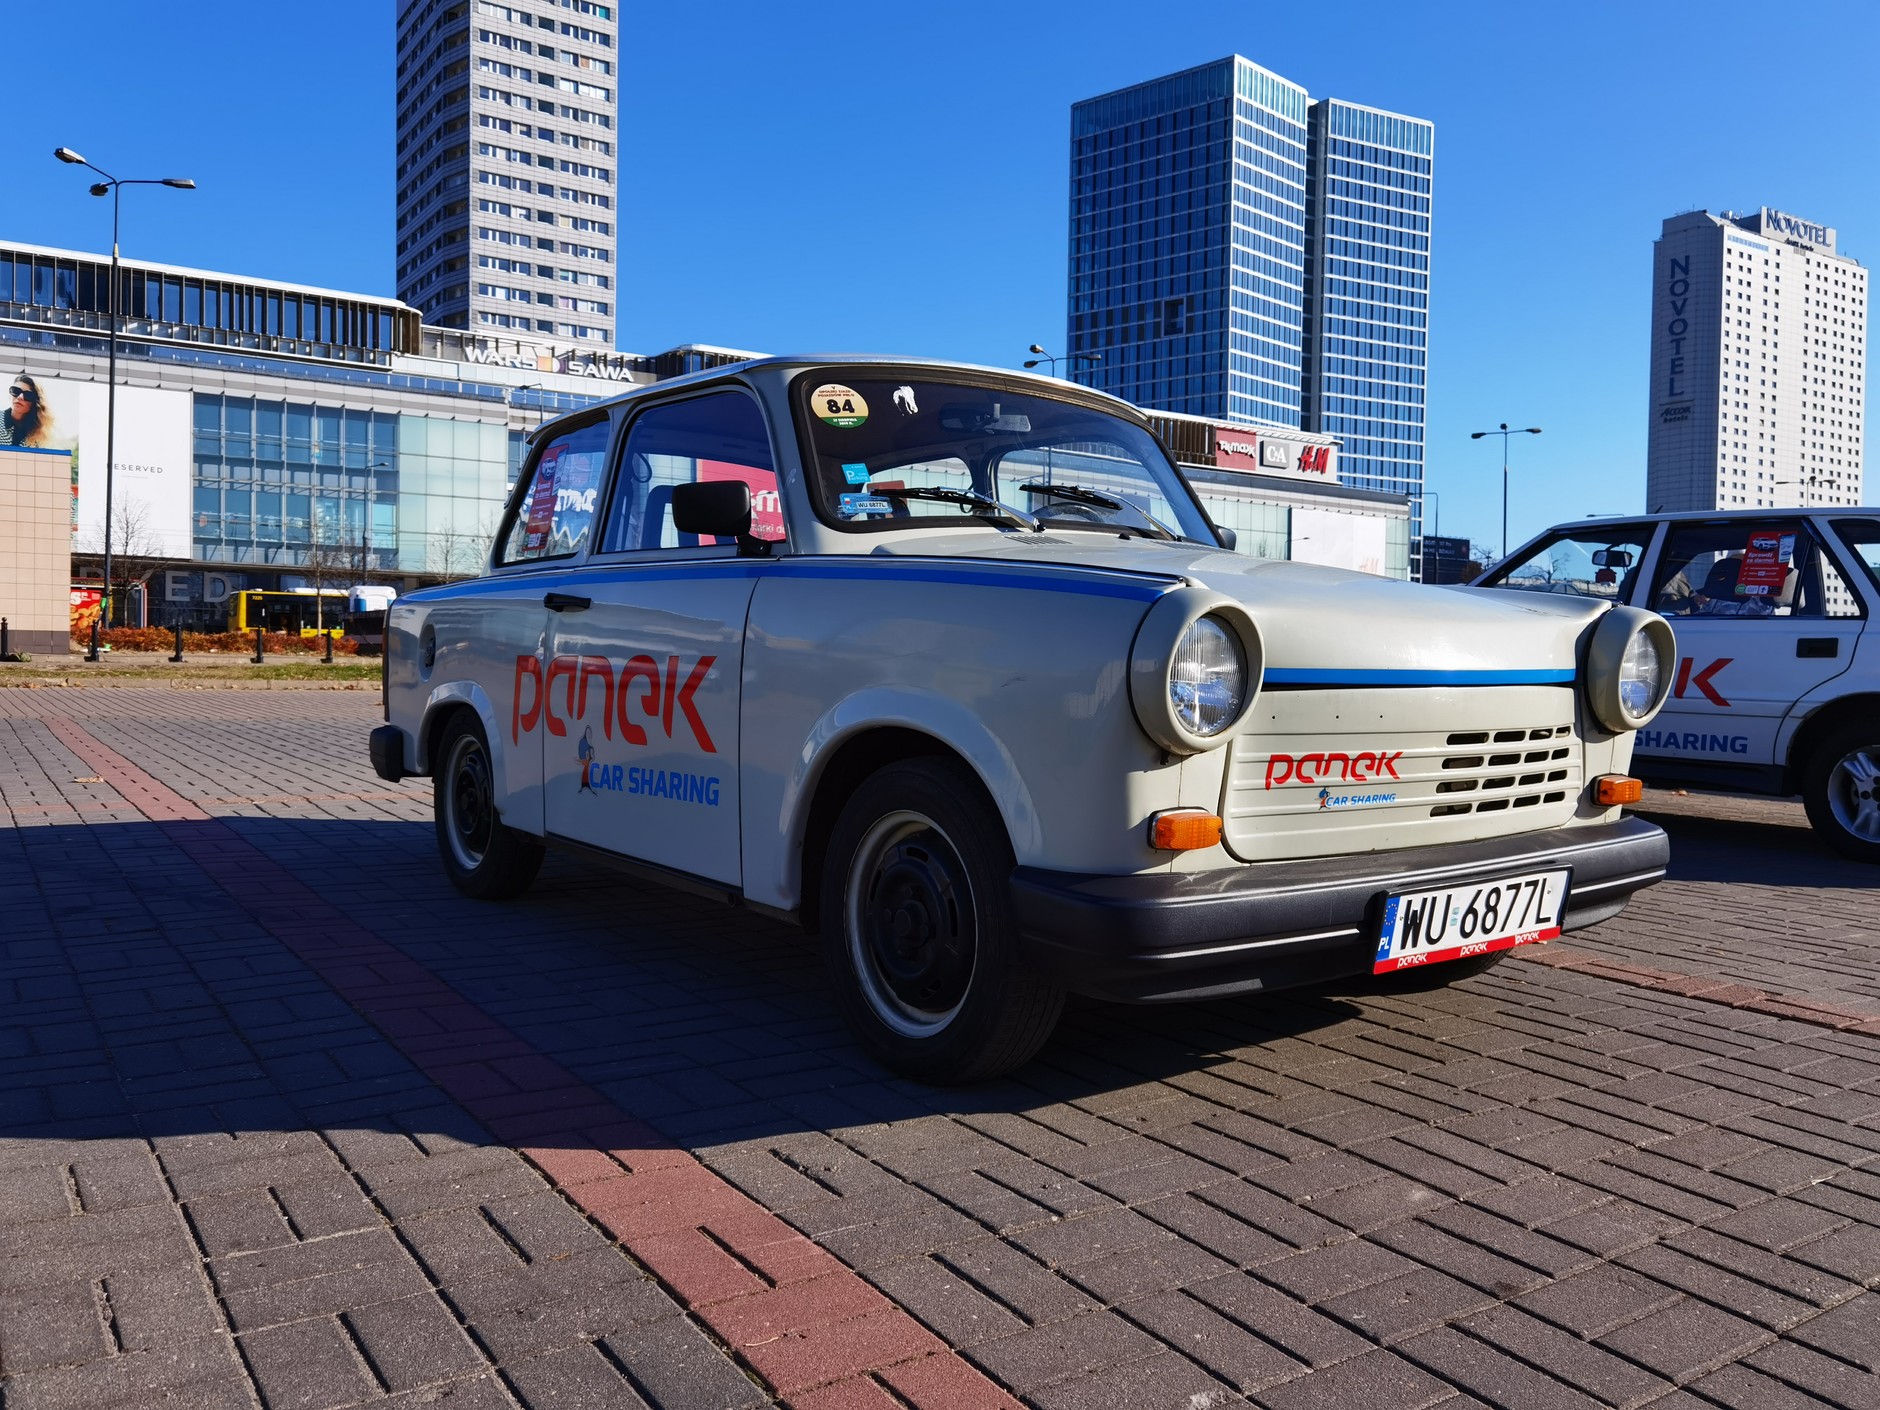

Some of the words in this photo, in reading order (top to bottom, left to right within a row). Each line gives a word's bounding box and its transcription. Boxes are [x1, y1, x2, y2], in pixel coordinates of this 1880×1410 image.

[1767, 208, 1831, 247] NOVOTEL
[1668, 255, 1690, 397] NOVOTEL
[465, 346, 537, 370] WARS
[569, 361, 634, 382] SAWA
[826, 399, 855, 414] 84
[1266, 445, 1287, 463] C&A
[107, 463, 163, 473] ESERVED
[1634, 730, 1748, 754] SHARING
[589, 763, 623, 791] CAR
[629, 767, 720, 806] SHARING
[1326, 797, 1348, 807] CAR
[1350, 793, 1396, 805] SHARING
[1401, 894, 1452, 950] WU
[1459, 877, 1551, 939] 6877L
[1378, 936, 1389, 951] PL
